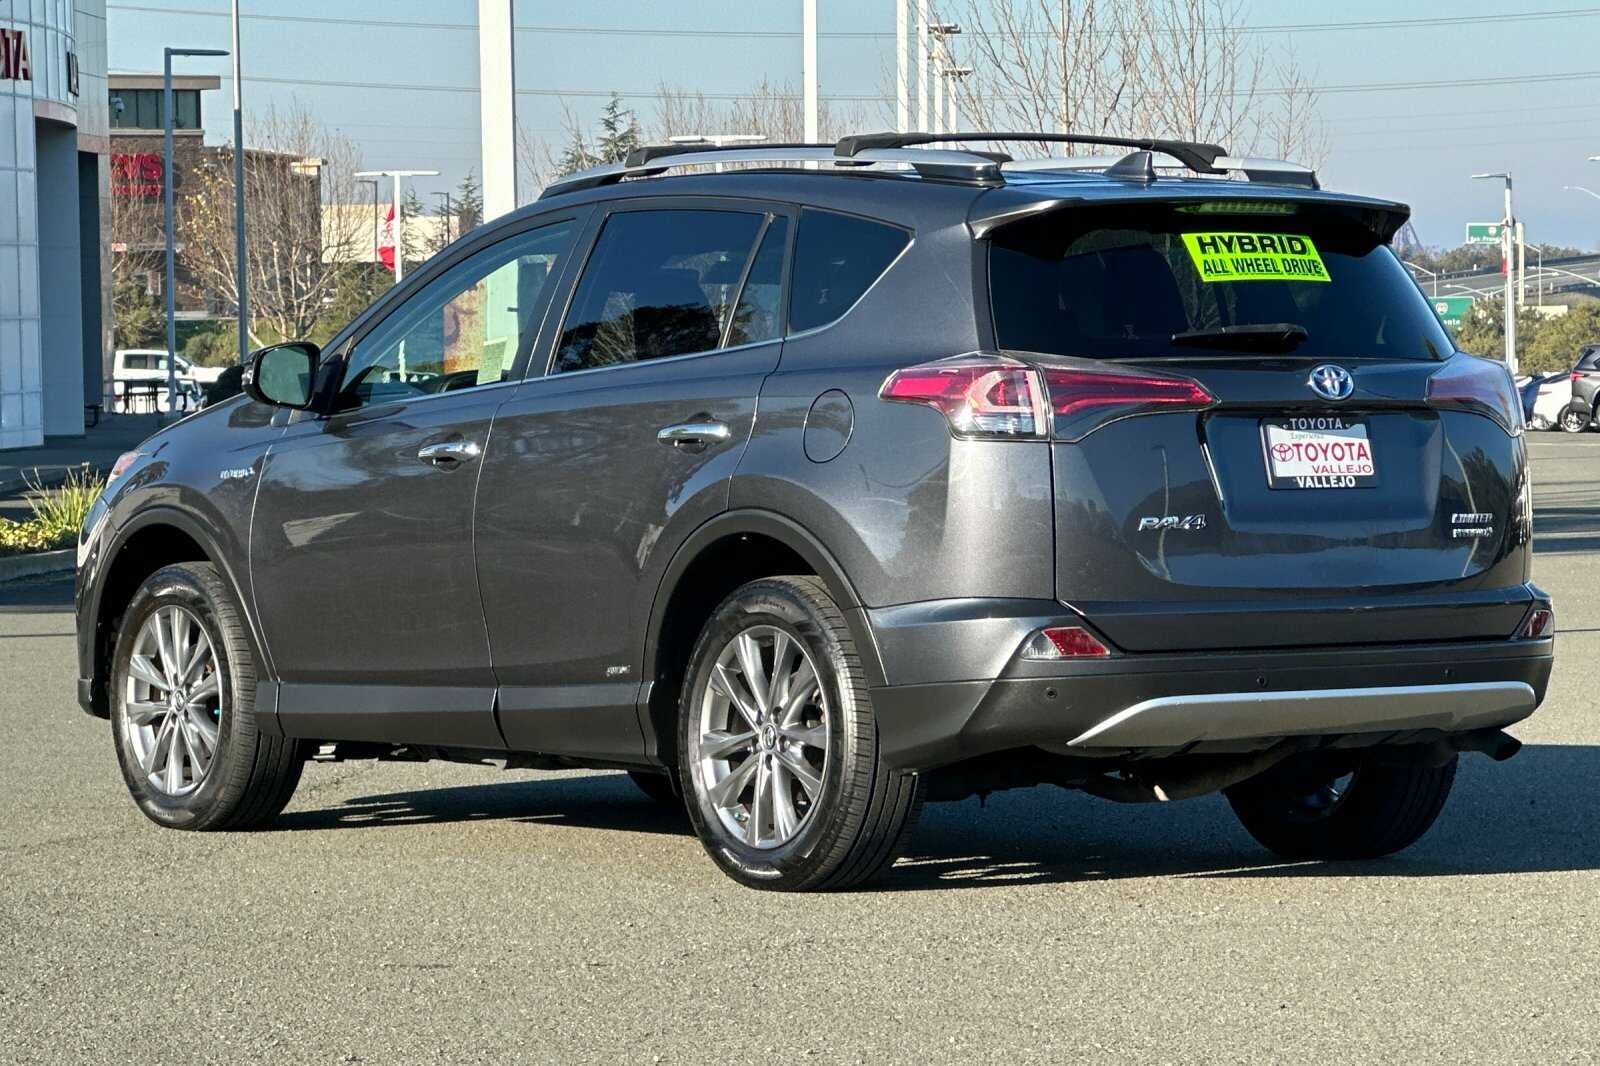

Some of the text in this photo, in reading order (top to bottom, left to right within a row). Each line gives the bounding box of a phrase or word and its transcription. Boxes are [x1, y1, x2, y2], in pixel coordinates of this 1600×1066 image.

[1196, 235, 1309, 256] HYBRID
[1203, 257, 1323, 275] ALL WHEEL DRIVE
[1289, 418, 1343, 430] TOYOTA
[1292, 442, 1370, 462] TOYOTA
[1312, 464, 1372, 474] VALLEJO
[1296, 476, 1356, 488] VALLEJO
[1138, 514, 1206, 531] RAV4
